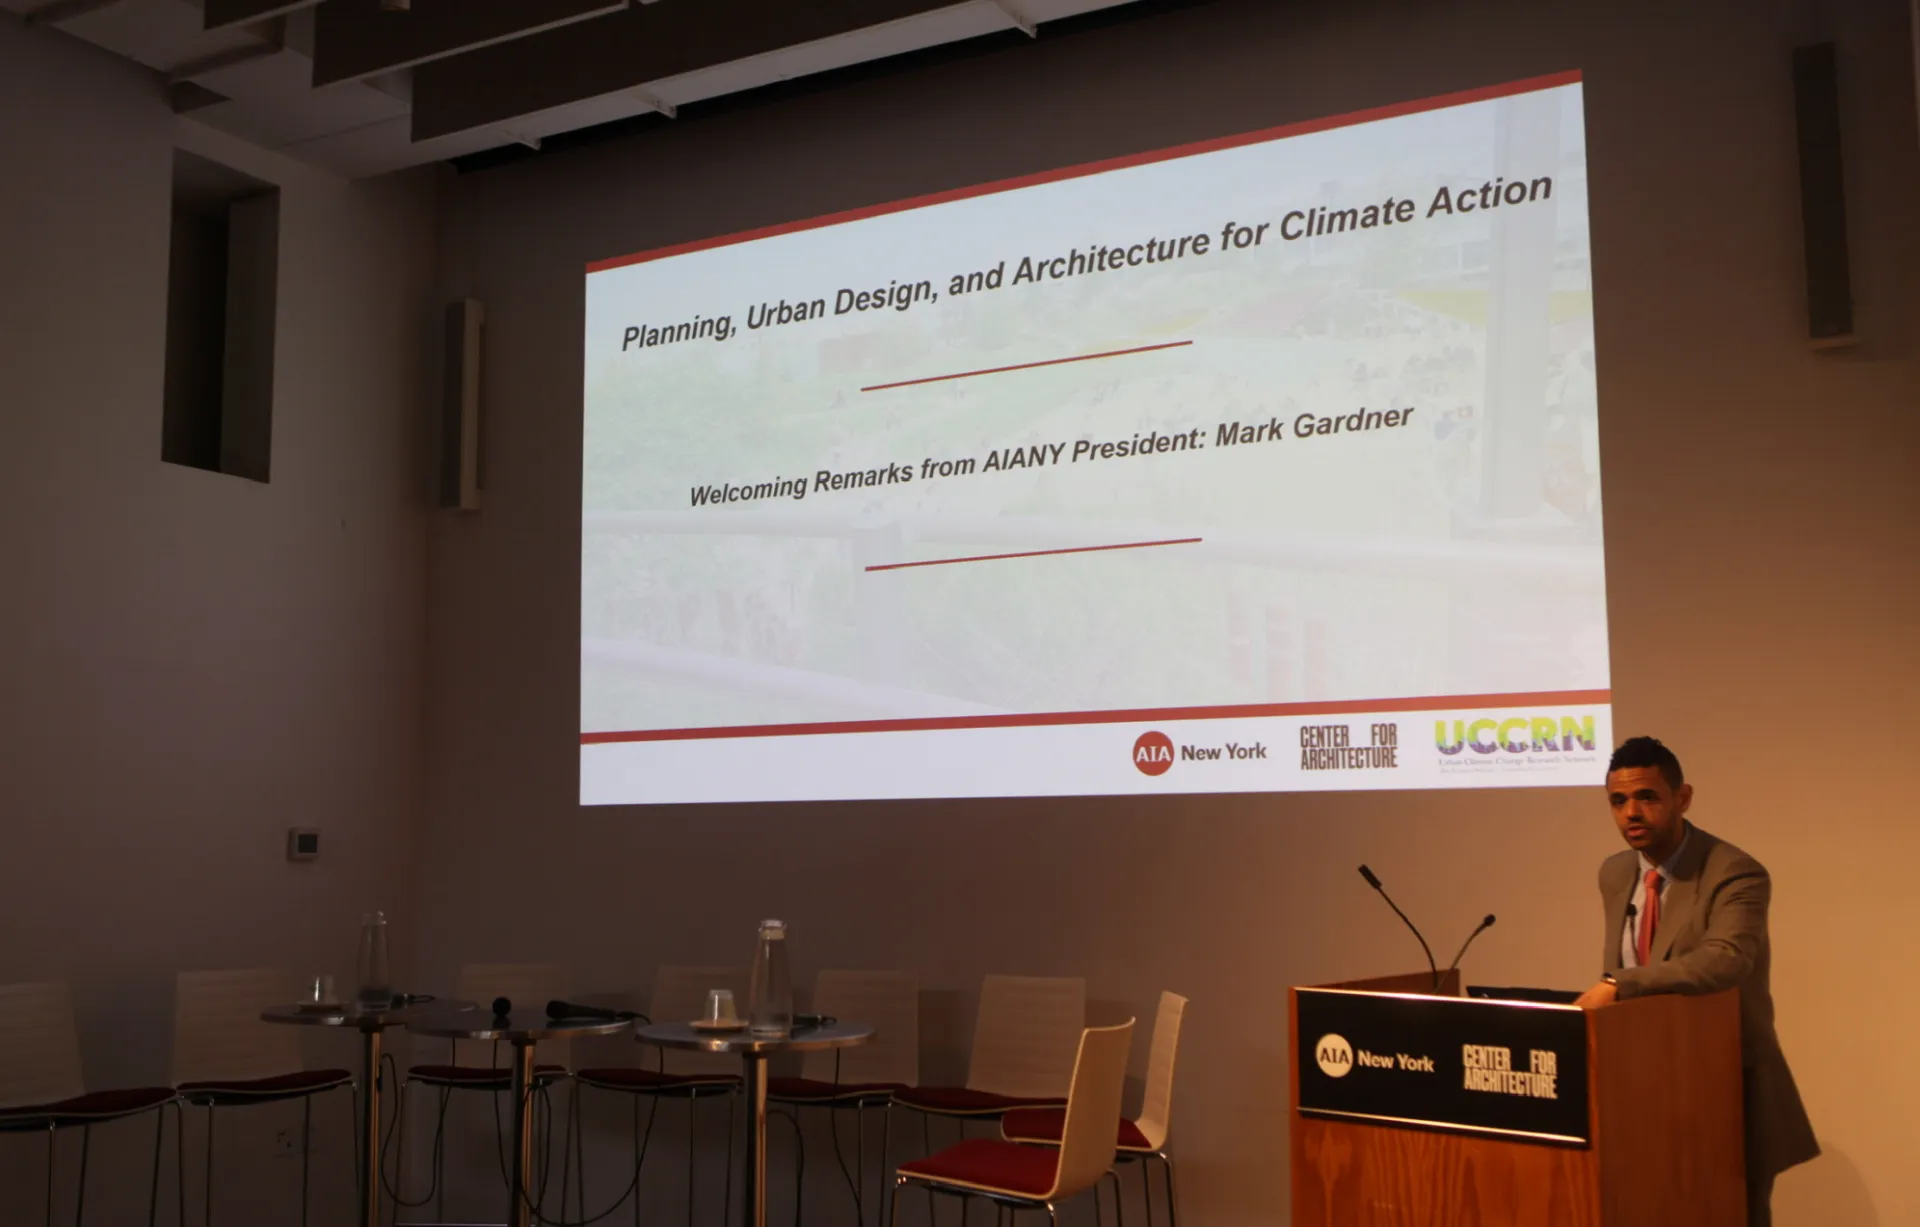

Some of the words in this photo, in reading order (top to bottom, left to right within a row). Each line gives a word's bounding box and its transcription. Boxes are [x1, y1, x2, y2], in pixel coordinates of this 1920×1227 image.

[621, 314, 737, 352] Planning,
[747, 298, 826, 330] Urban
[834, 280, 938, 316] Design,
[948, 260, 1006, 297] and
[1011, 233, 1211, 286] Architecture
[1220, 221, 1271, 251] for
[1280, 196, 1416, 241] Climate
[1425, 176, 1553, 219] Action
[690, 475, 808, 507] Welcoming
[813, 462, 914, 493] Remarks
[920, 457, 976, 480] from
[981, 442, 1067, 473] AIANY
[1071, 427, 1207, 463] President:
[1215, 417, 1285, 447] Mark
[1293, 406, 1415, 439] Gardner
[1300, 725, 1349, 748] CENTER
[1371, 723, 1398, 745] FOR
[1434, 715, 1596, 755] UCCRN
[1136, 745, 1171, 762] AIA
[1181, 745, 1221, 761] New
[1225, 742, 1267, 760] York
[1300, 747, 1399, 770] ARCHITECTURE
[1320, 1047, 1350, 1064] AIA
[1357, 1049, 1394, 1069] New
[1396, 1052, 1435, 1073] York
[1462, 1044, 1511, 1071] CENTER
[1529, 1049, 1558, 1074] FOR
[1463, 1068, 1558, 1100] ARCHITECTURE
